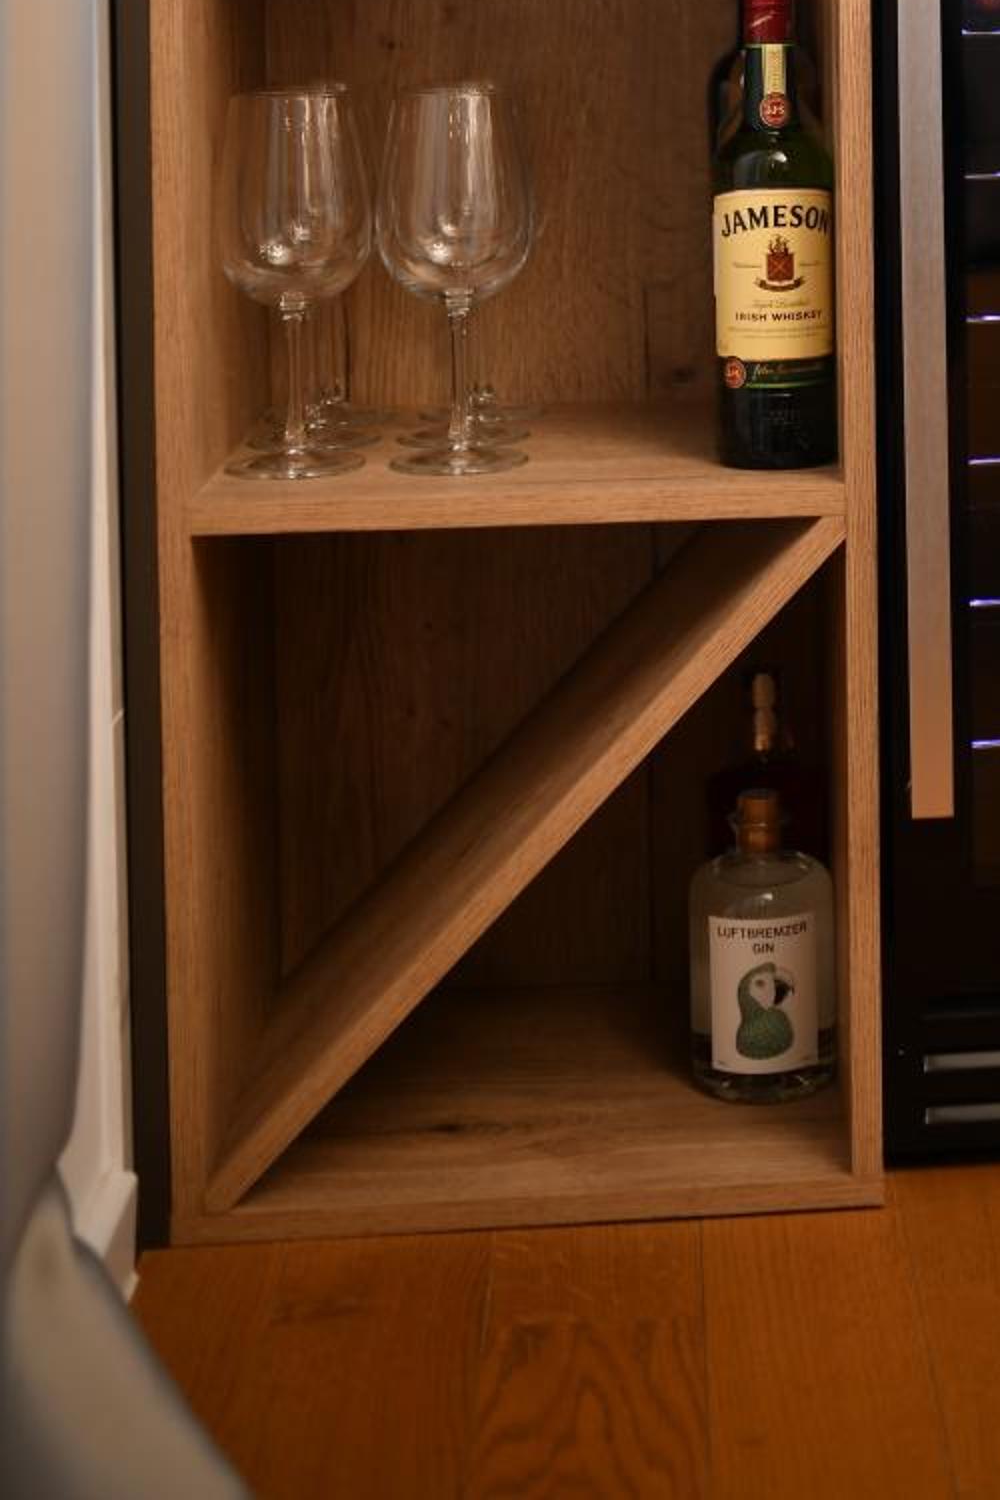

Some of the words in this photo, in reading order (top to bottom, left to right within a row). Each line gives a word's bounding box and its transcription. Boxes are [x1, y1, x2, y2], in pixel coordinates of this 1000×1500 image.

[721, 204, 830, 238] JAMESON
[735, 311, 767, 322] IRISH
[752, 942, 775, 956] GIN
